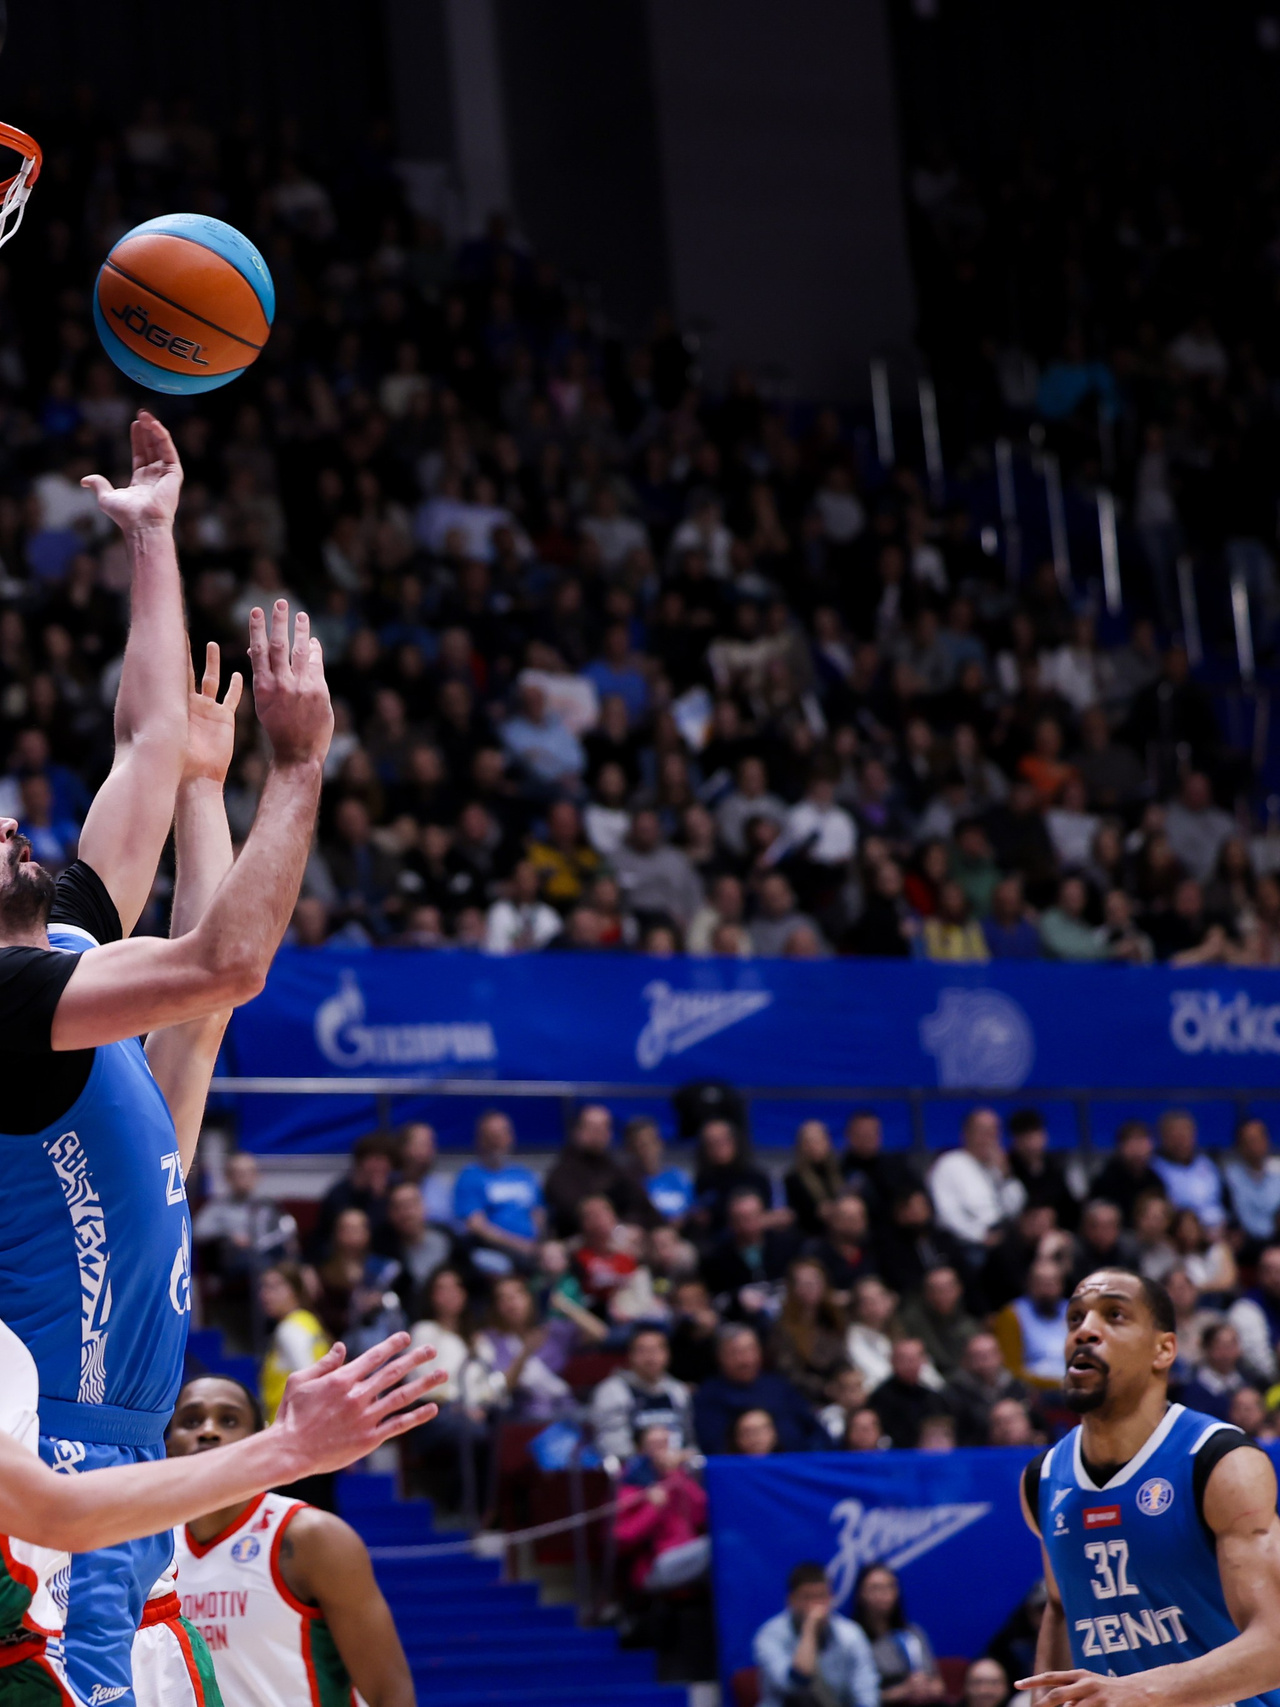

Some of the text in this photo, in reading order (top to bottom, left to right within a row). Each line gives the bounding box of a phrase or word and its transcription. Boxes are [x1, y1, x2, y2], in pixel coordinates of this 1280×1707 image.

[111, 305, 209, 366] JÖGEL
[1084, 1539, 1139, 1600] 32
[1075, 1605, 1189, 1657] ZENIT
